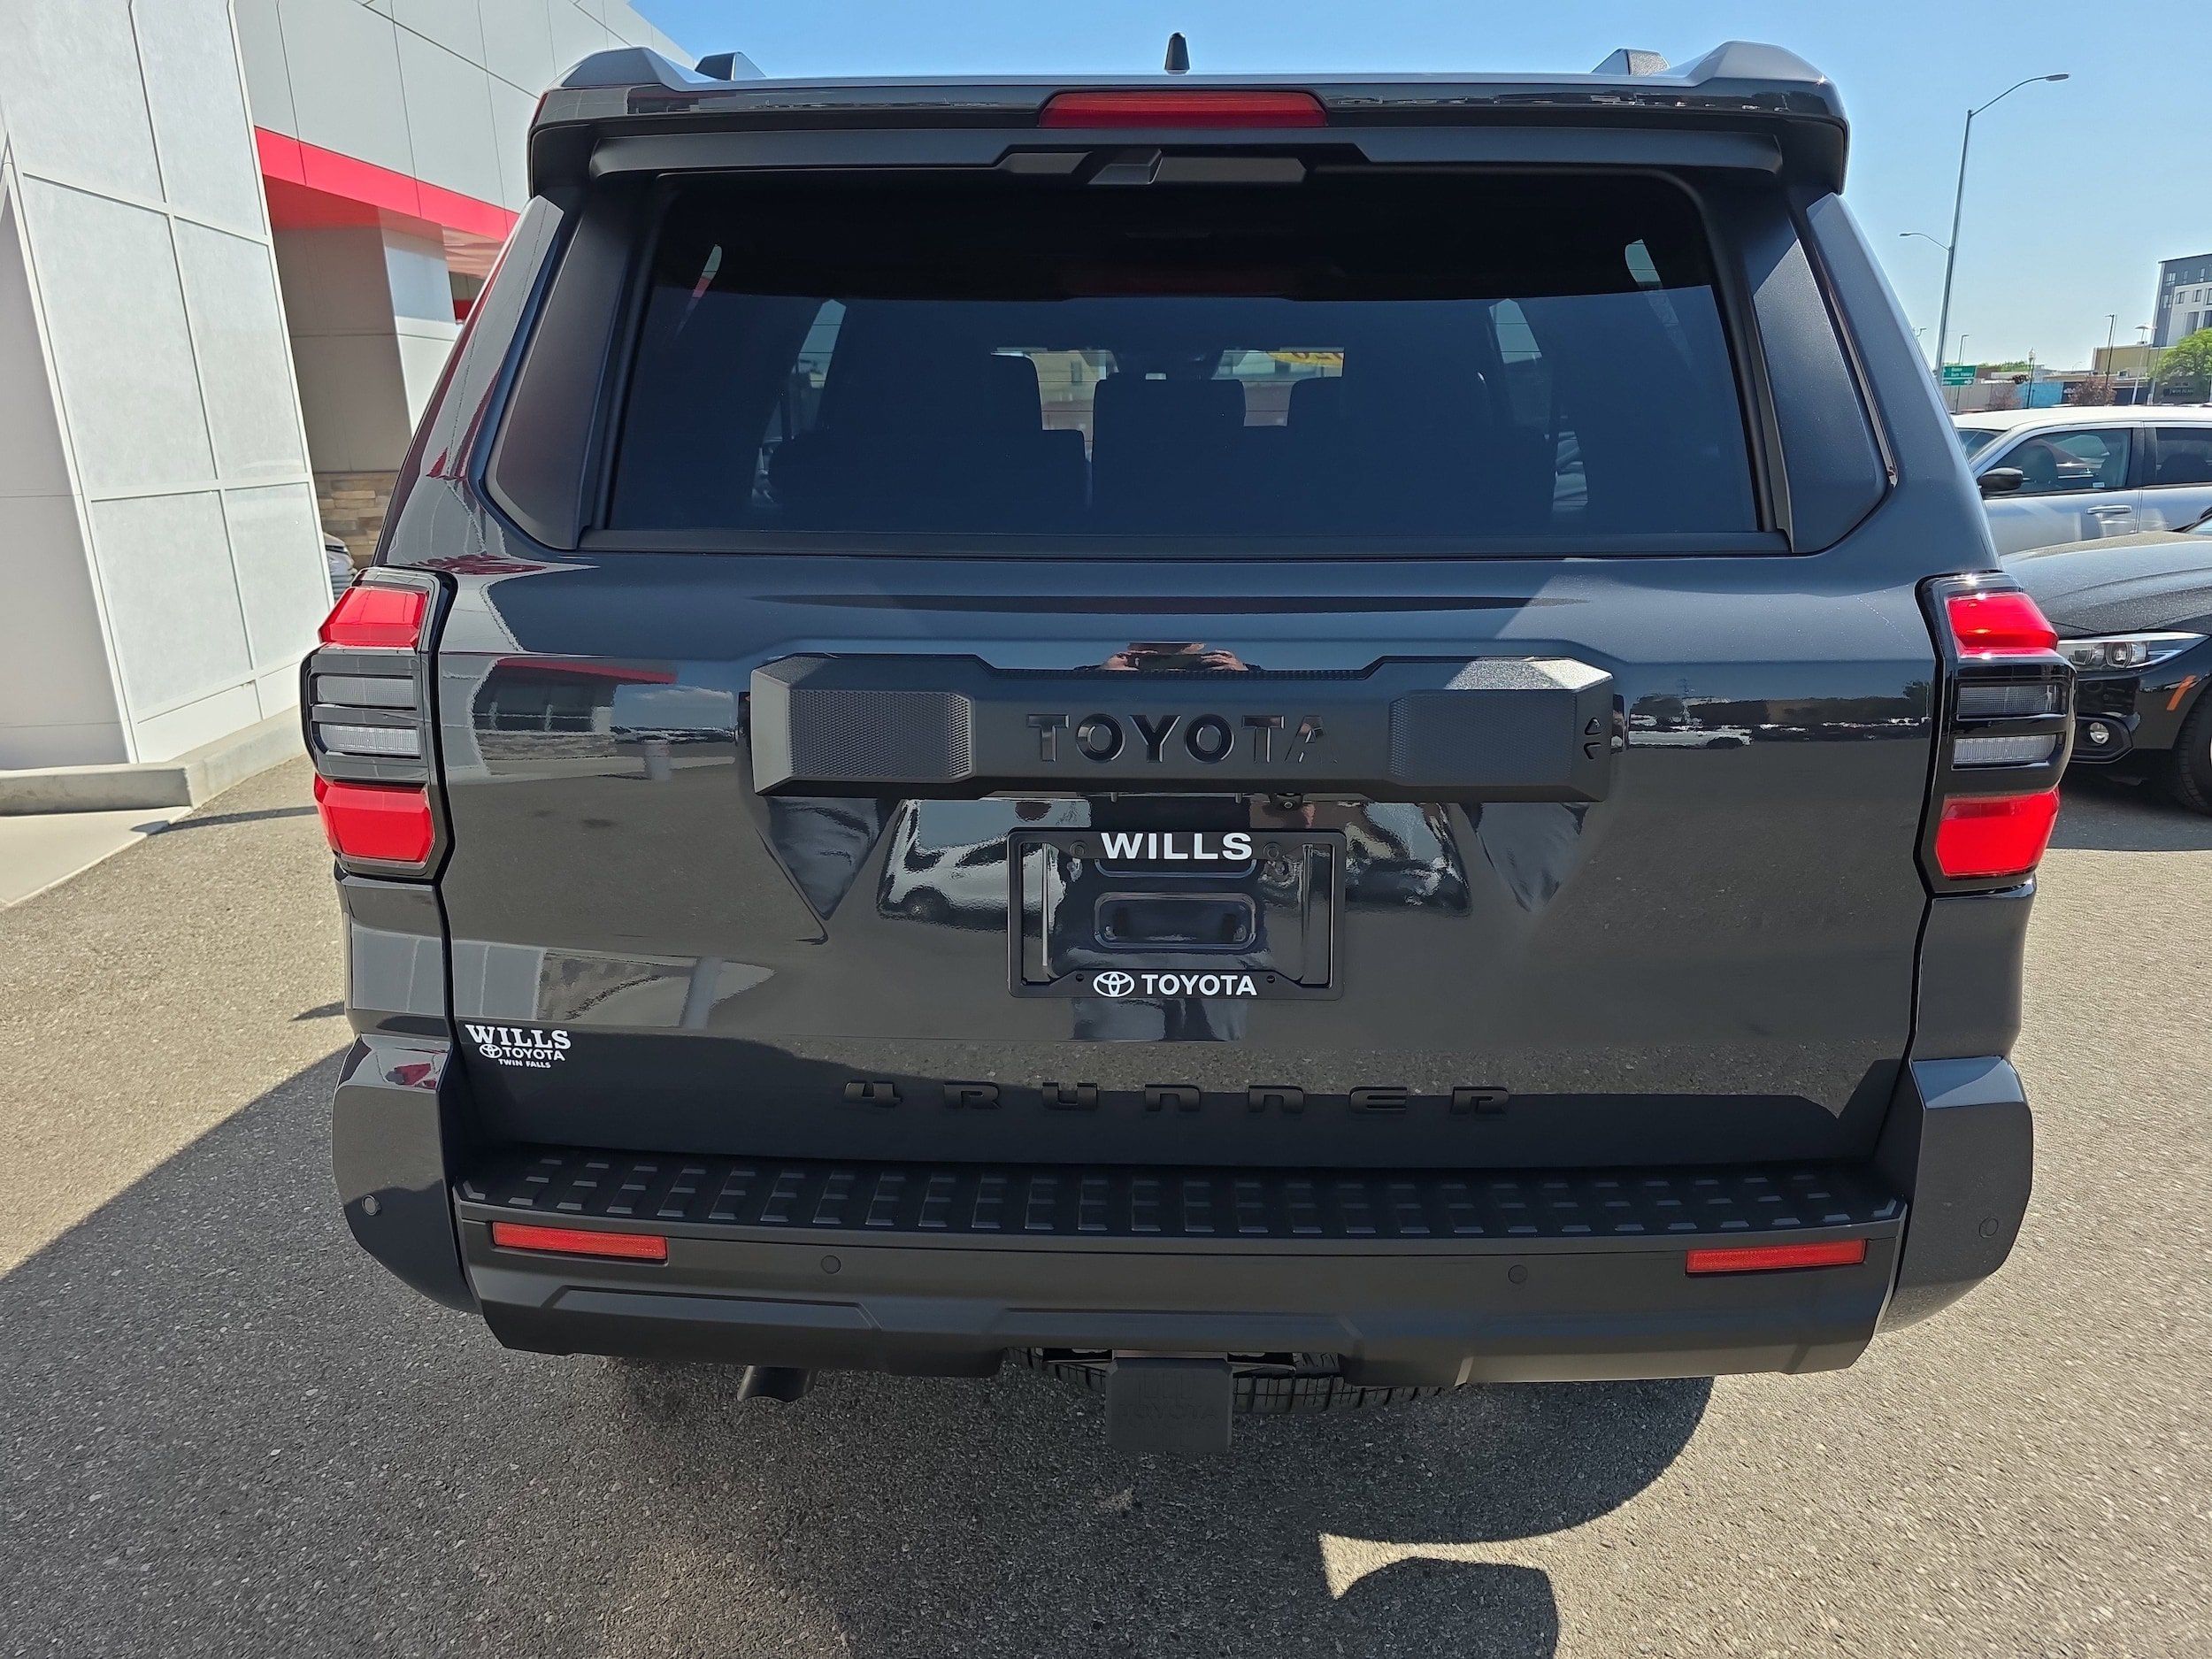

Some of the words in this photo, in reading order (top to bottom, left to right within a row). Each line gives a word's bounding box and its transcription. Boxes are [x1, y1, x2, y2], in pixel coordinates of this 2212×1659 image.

[1026, 713, 1337, 764] TOYOTA
[1100, 832, 1253, 860] WILLS
[1141, 973, 1257, 997] TOYOTA
[465, 1024, 572, 1050] WILLS
[497, 1058, 523, 1067] TWIN
[526, 1060, 552, 1069] FALLS
[502, 1047, 566, 1062] TOYOTA
[841, 1081, 1510, 1115] 4RUNNER
